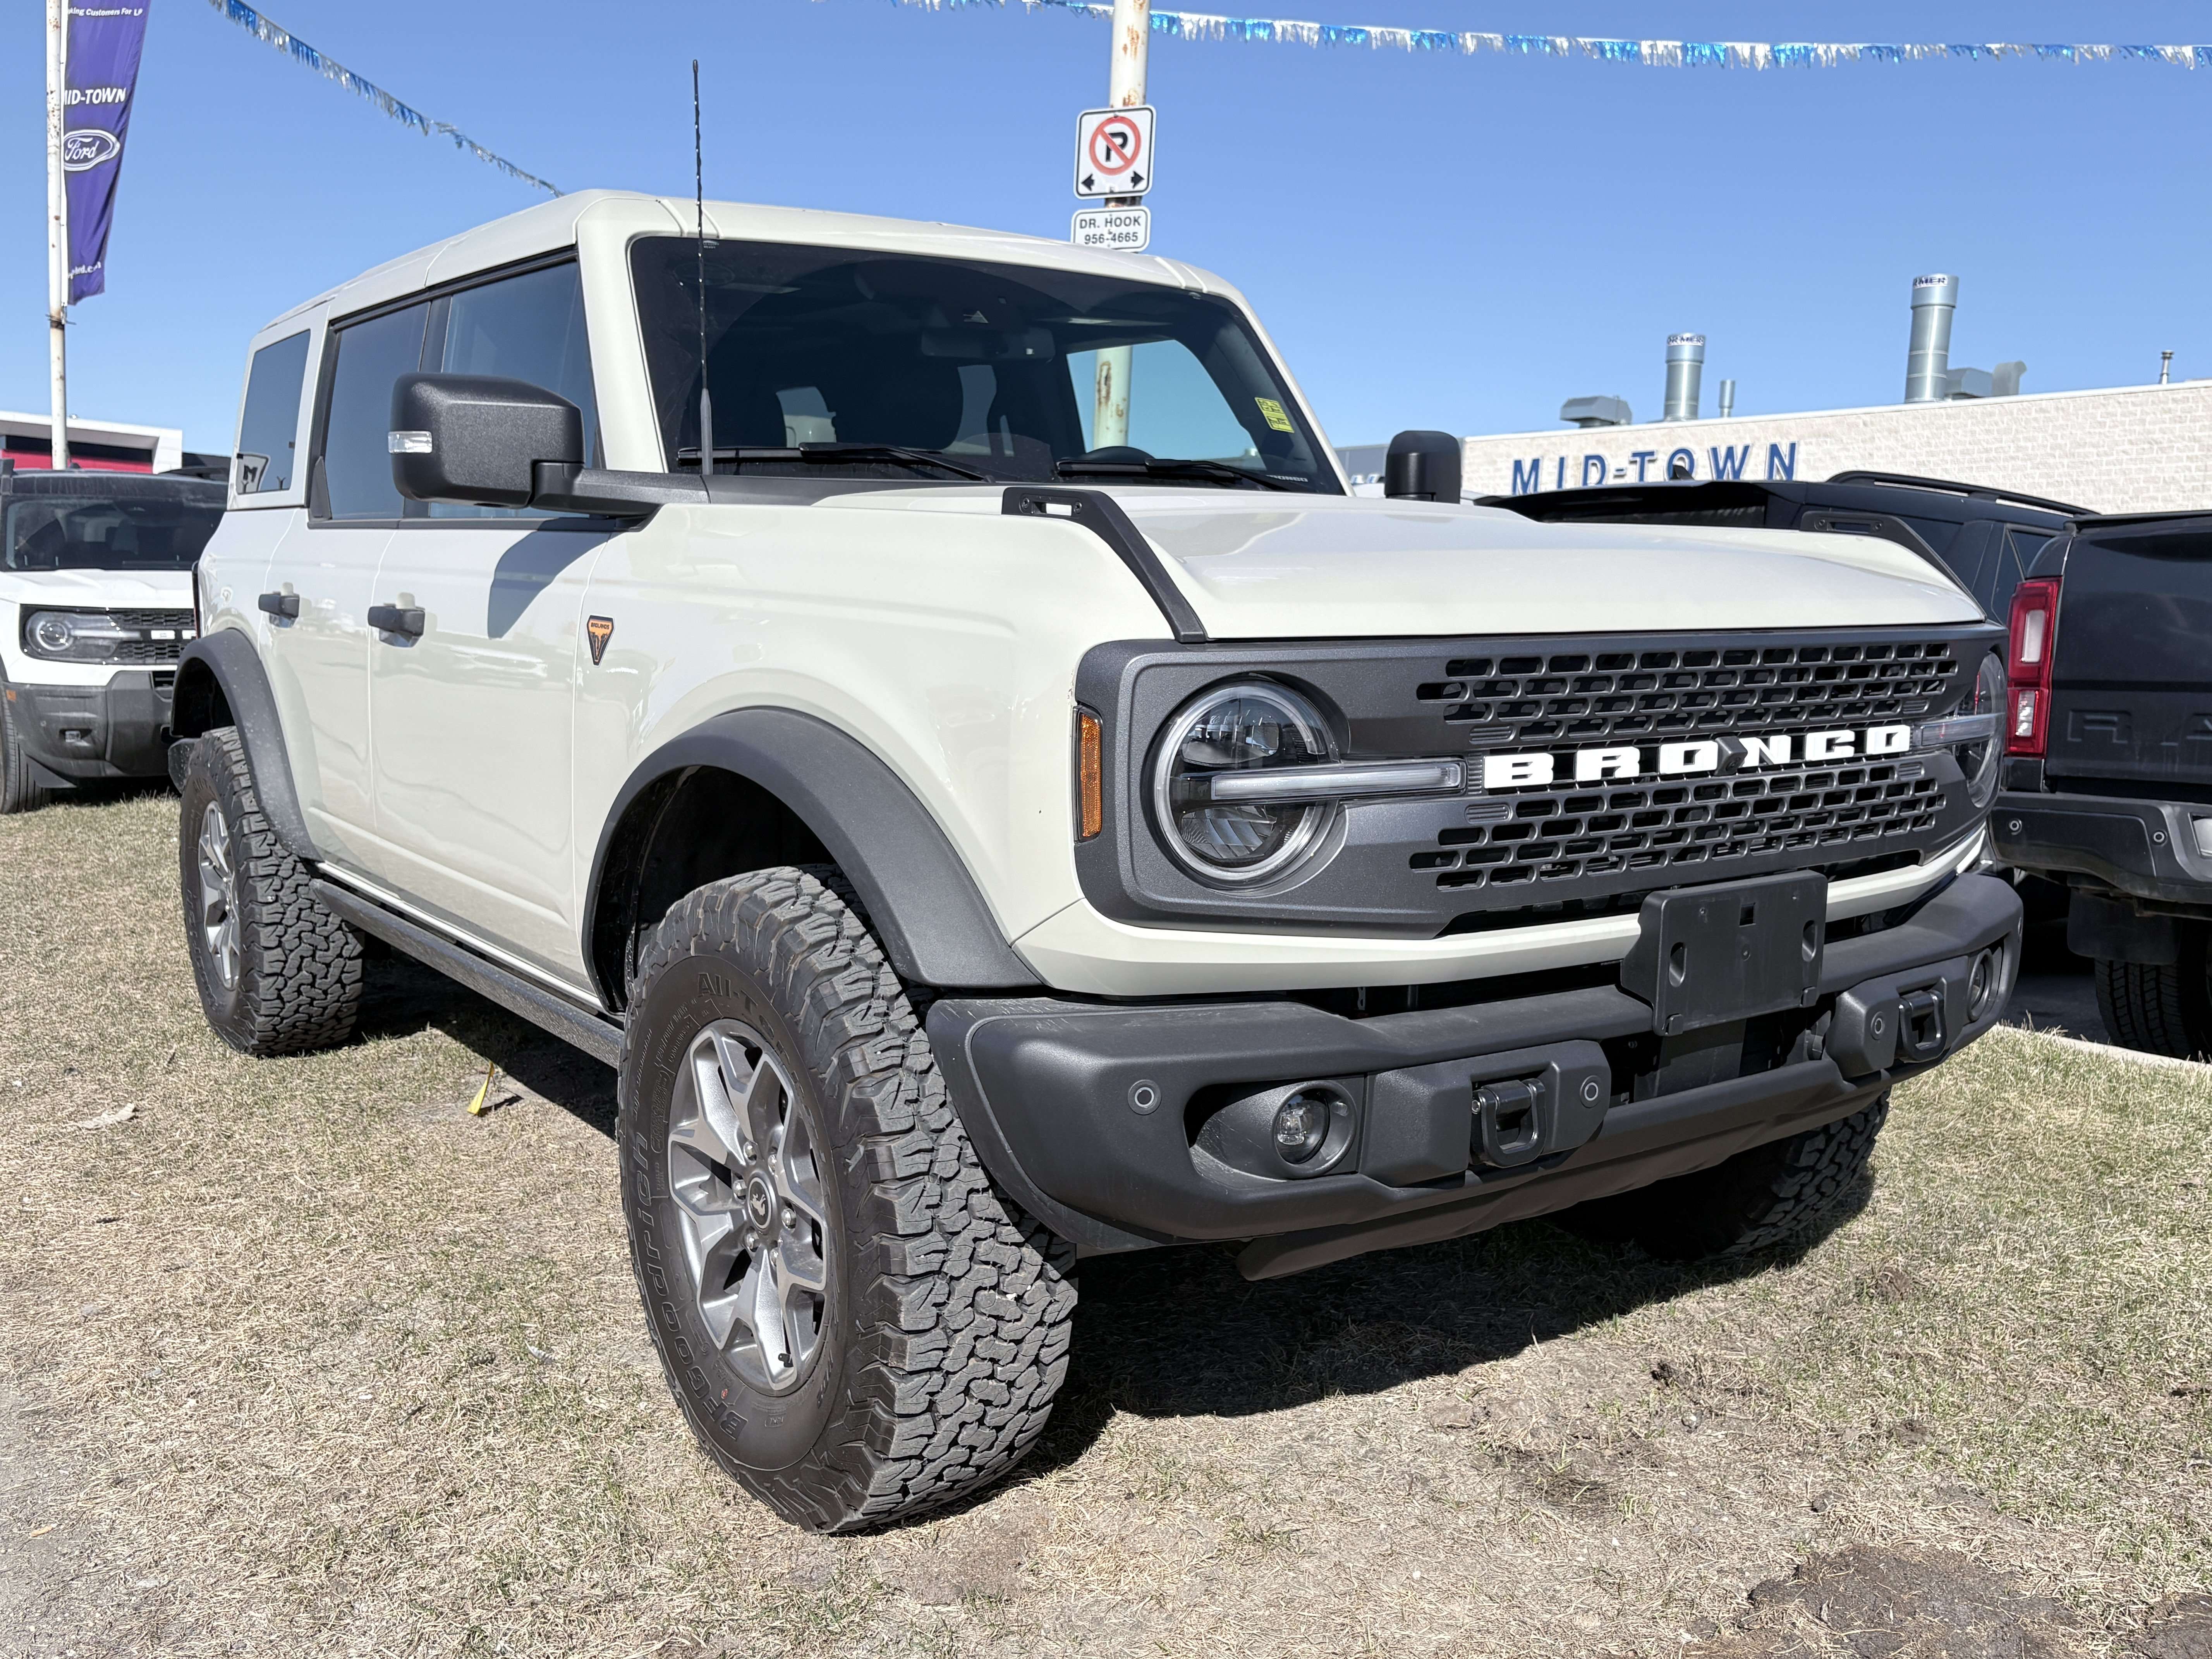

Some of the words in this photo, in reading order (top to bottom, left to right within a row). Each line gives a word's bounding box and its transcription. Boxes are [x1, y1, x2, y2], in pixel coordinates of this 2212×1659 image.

[86, 8, 120, 16] Customers
[65, 137, 100, 161] Ford
[1079, 219, 1100, 229] DR.
[1105, 216, 1142, 228] HOOK
[1084, 232, 1139, 245] 956-4665
[1511, 441, 1798, 496] MID-TOWN
[1484, 724, 1911, 789] BRONCO
[632, 1132, 749, 1441] BFGoodrich
